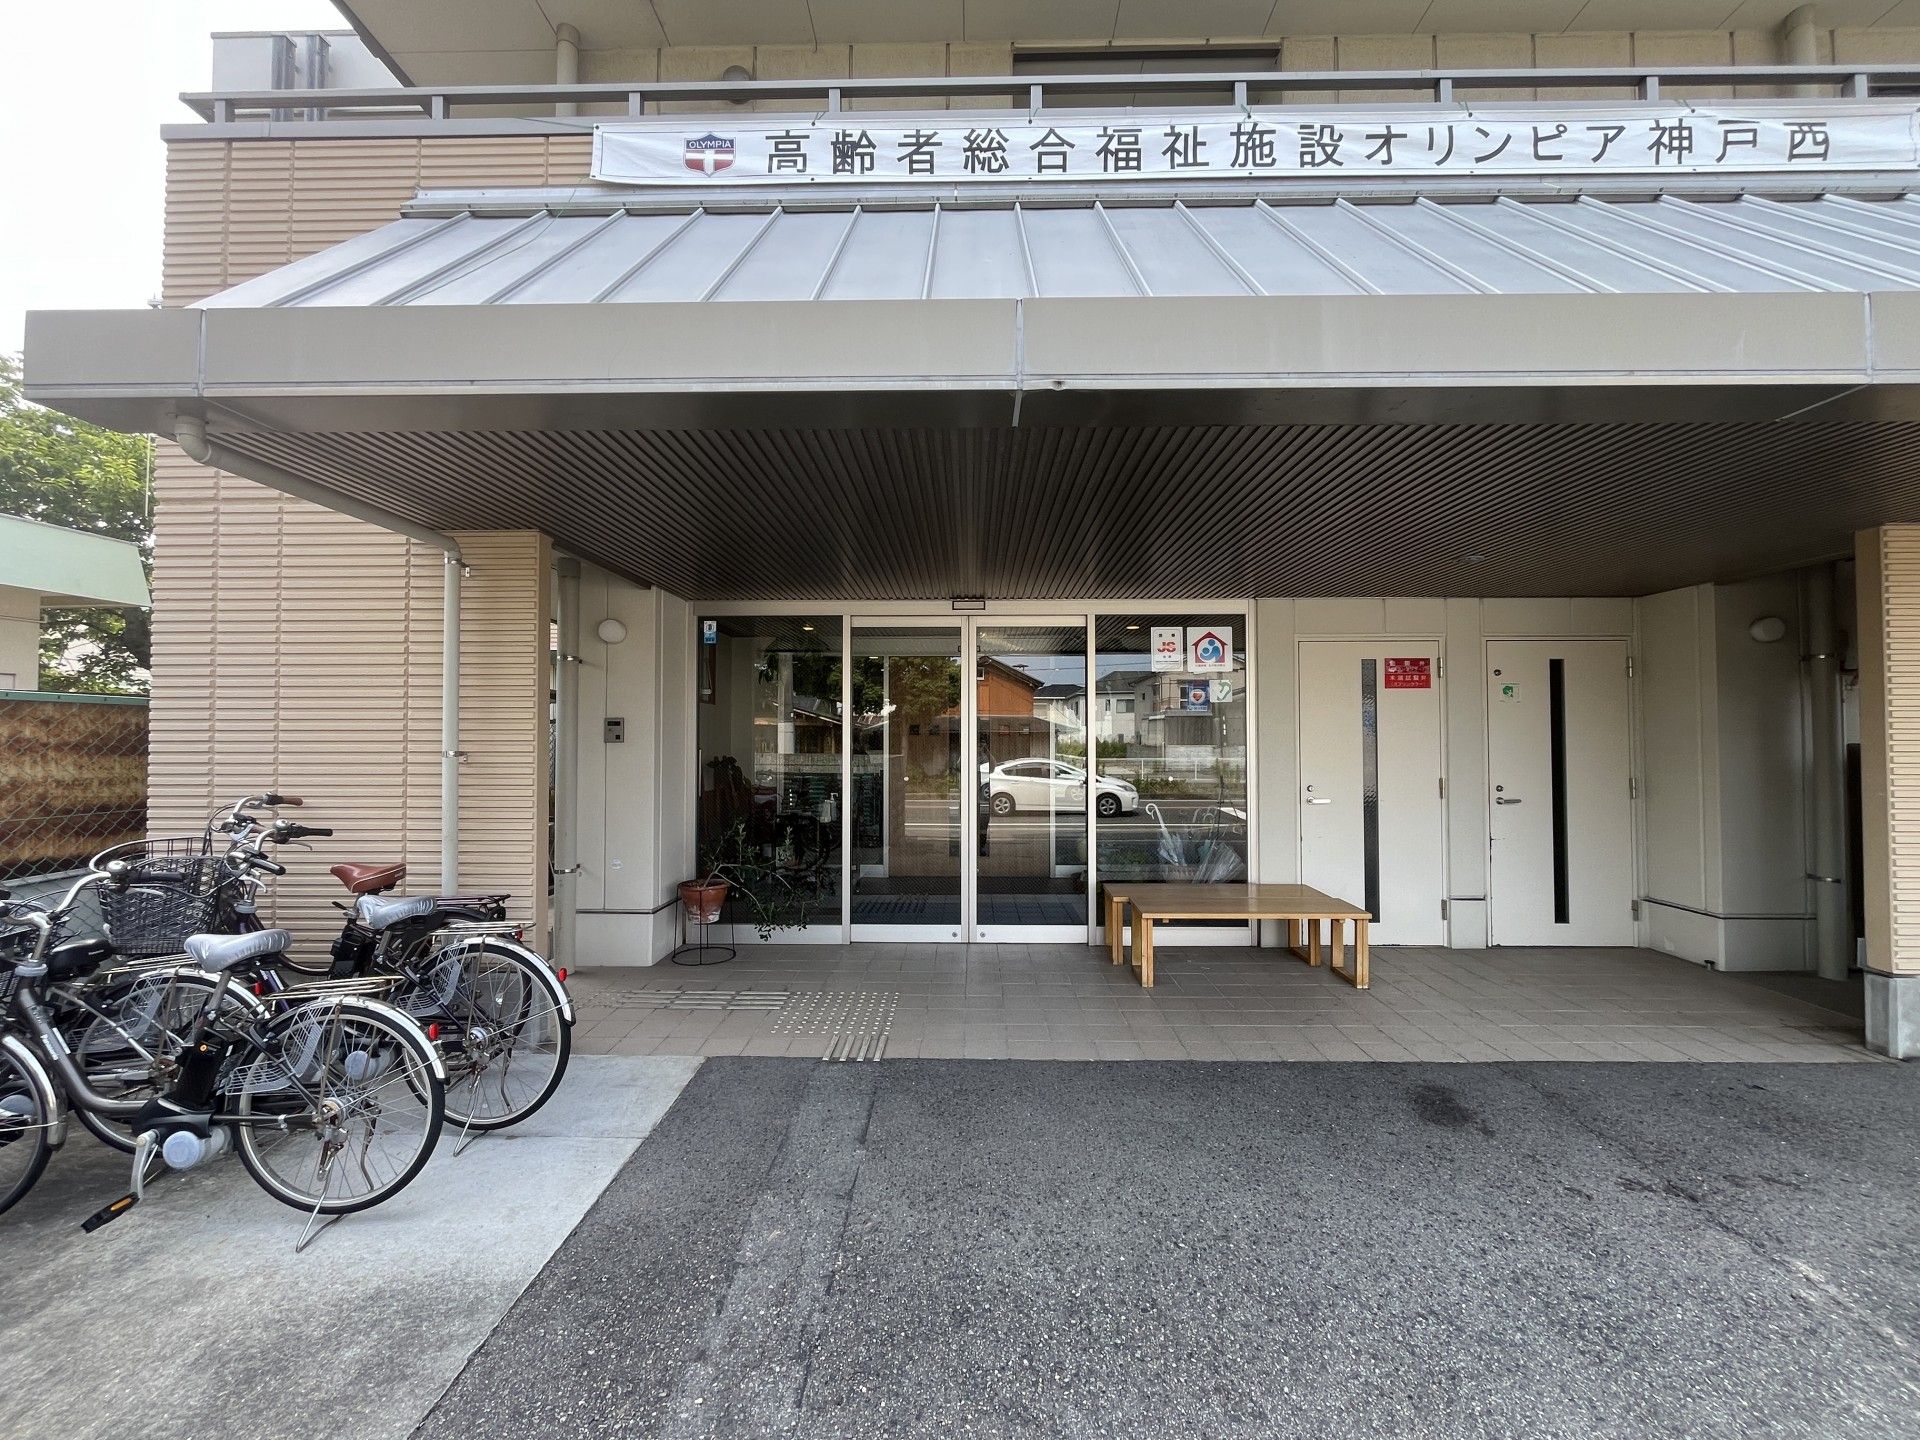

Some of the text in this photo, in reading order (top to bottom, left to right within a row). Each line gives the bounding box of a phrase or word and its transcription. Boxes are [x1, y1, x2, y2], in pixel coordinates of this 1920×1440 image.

[688, 140, 732, 149] OLYMPIA
[764, 118, 1831, 175] 高齢者総合福祉施設オリンピア神戸西
